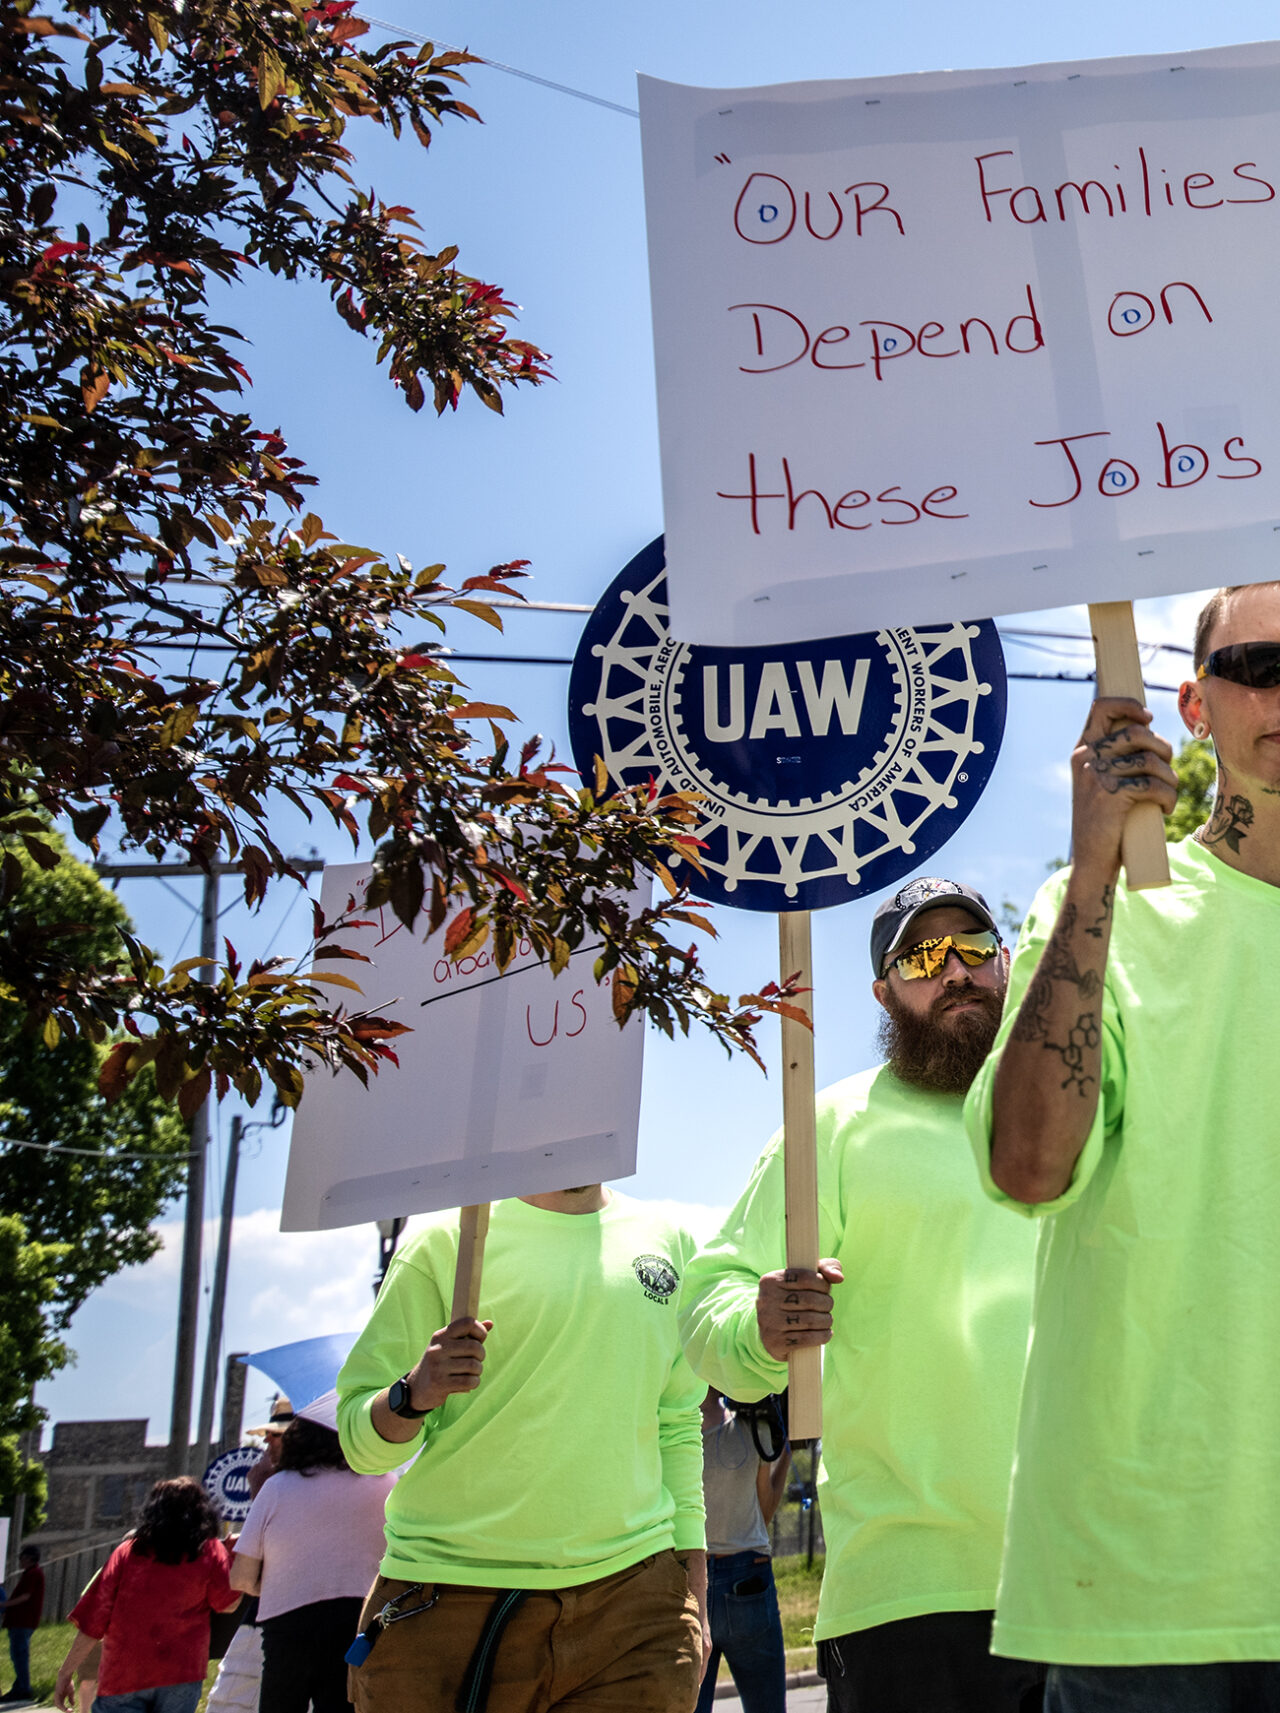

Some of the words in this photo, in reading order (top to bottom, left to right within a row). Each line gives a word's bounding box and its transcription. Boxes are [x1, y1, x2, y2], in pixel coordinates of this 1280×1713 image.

[974, 146, 1276, 226] Families
[727, 283, 1046, 381] Depend
[1107, 281, 1214, 336] on
[716, 451, 970, 536] these
[649, 679, 683, 776] AUTOMOBILE,
[702, 658, 871, 743] UAW
[911, 661, 926, 733] WORKERS
[901, 737, 917, 759] OF
[680, 778, 726, 817] UNED
[848, 761, 903, 813] AMERICA
[643, 1290, 664, 1305] LOCAL
